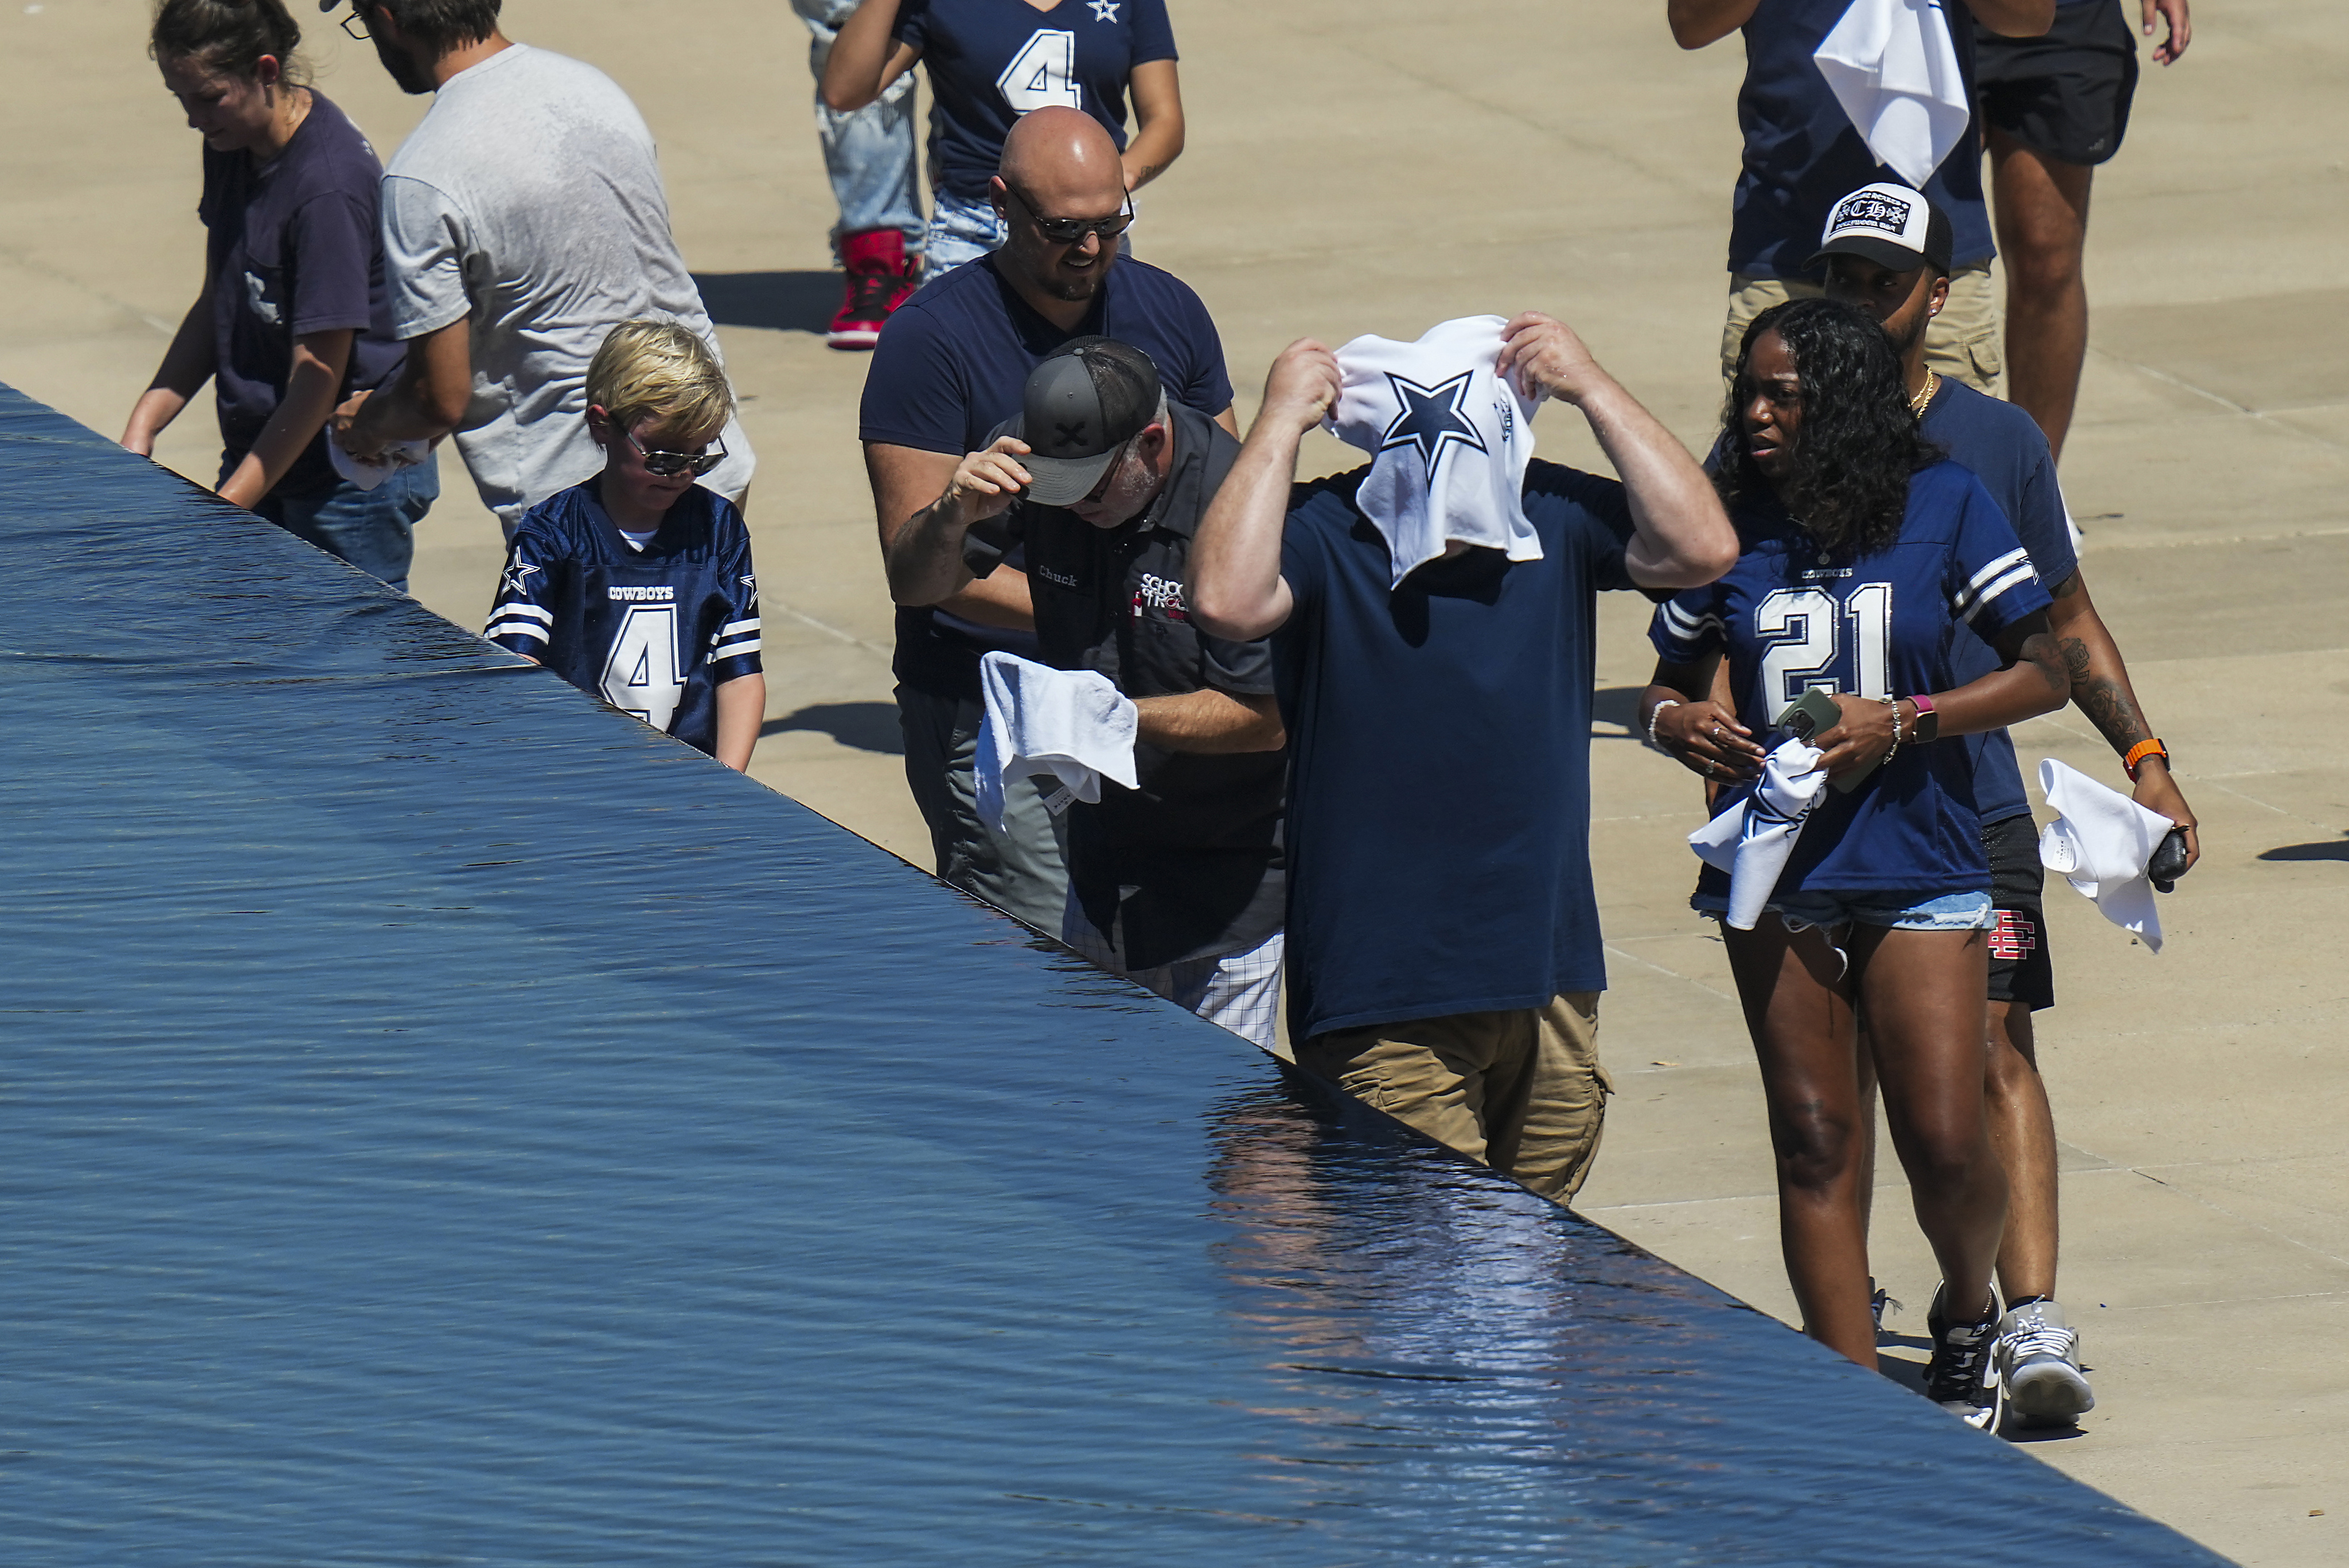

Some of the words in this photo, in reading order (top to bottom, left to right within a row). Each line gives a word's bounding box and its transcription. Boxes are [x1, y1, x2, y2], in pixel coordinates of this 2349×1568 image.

[996, 29, 1081, 115] 4
[1850, 200, 1886, 220] CH
[608, 586, 674, 600] COWBOYS
[1040, 565, 1078, 587] Chuck
[598, 603, 688, 732] 4
[1754, 582, 1894, 731] 21
